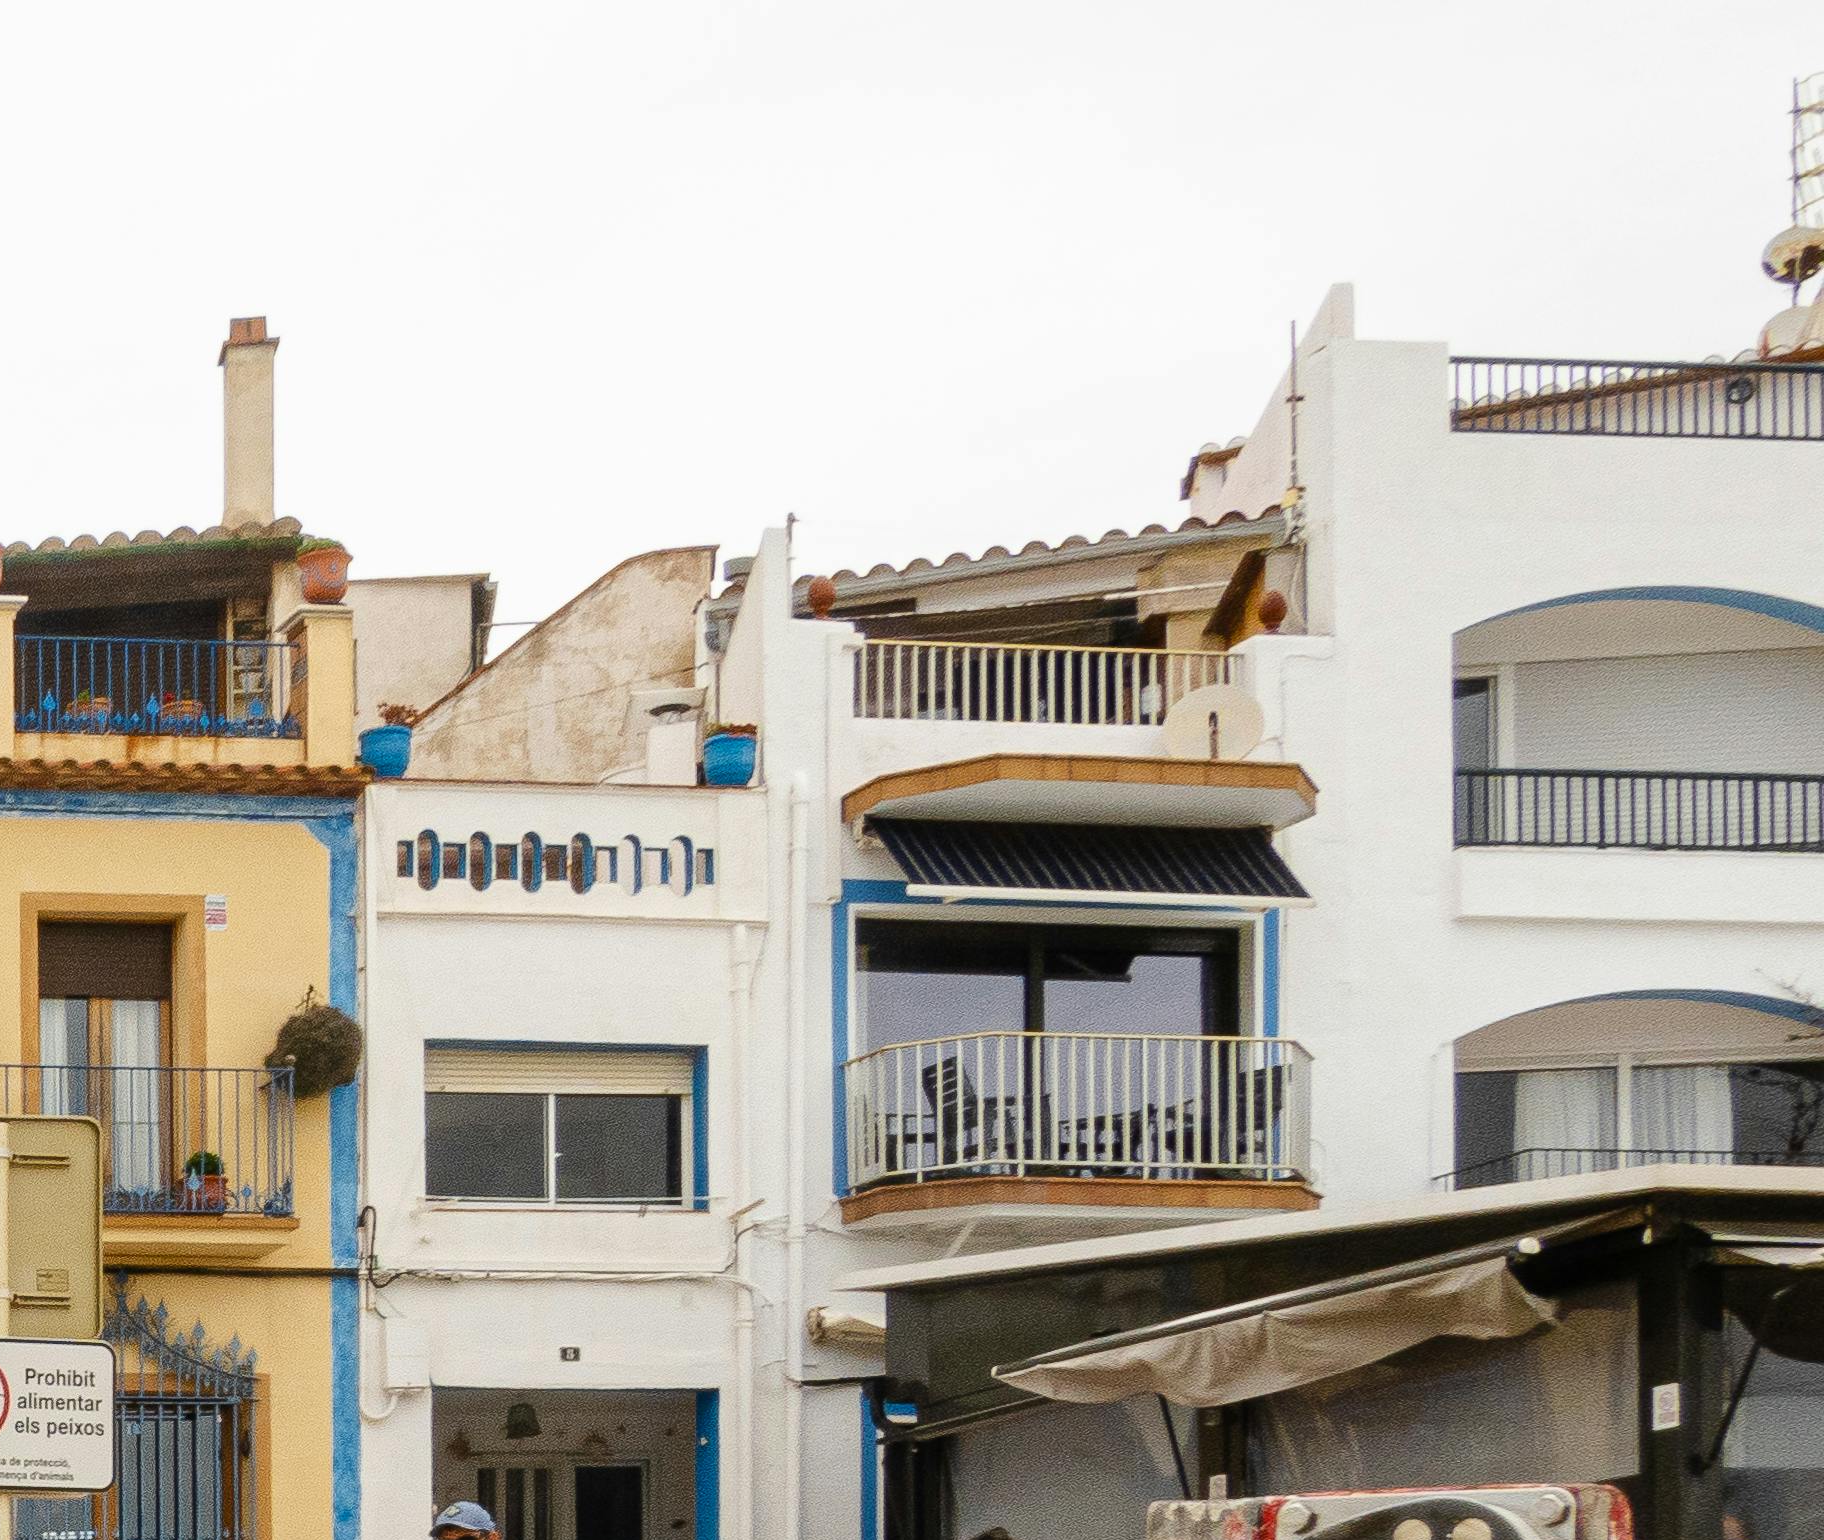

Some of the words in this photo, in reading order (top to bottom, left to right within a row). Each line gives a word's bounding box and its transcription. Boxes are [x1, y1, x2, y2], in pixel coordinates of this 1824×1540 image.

[24, 1367, 96, 1388] Prohibit
[16, 1392, 103, 1412] alimentar
[14, 1416, 40, 1434] els
[46, 1417, 105, 1438] peixos
[9, 1456, 21, 1467] de
[30, 1470, 75, 1481] d'animals
